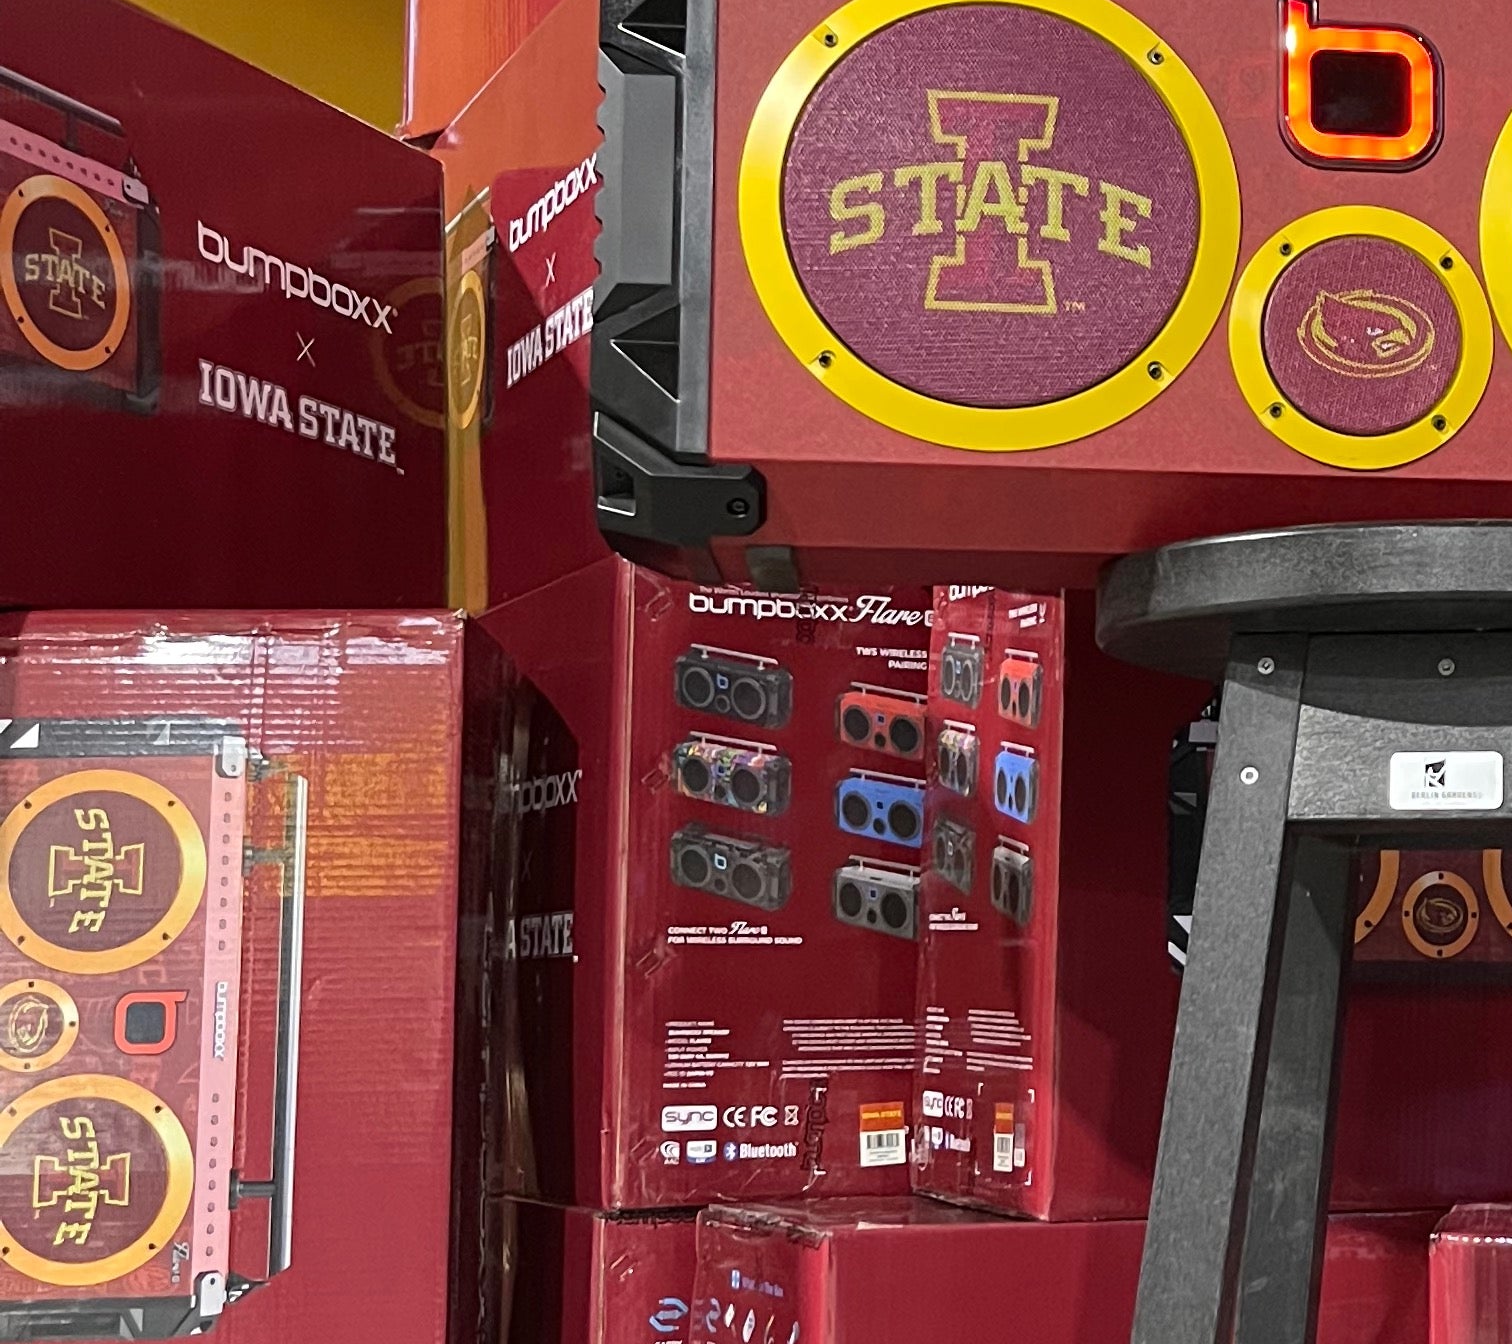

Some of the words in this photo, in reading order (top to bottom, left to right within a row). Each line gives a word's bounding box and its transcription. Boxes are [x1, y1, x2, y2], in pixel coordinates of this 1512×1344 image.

[509, 153, 597, 253] bumpboxx
[828, 160, 1153, 269] STATE
[25, 253, 105, 310] STATE
[198, 220, 395, 335] bumpboxx
[507, 323, 543, 389] IOWA
[544, 285, 594, 363] STATE
[199, 358, 293, 431] IOWA
[299, 396, 398, 467] STATE
[850, 595, 924, 625] Flare
[69, 808, 109, 933] STATE
[53, 1117, 93, 1246] STATE
[739, 1142, 797, 1160] Bluetooth
